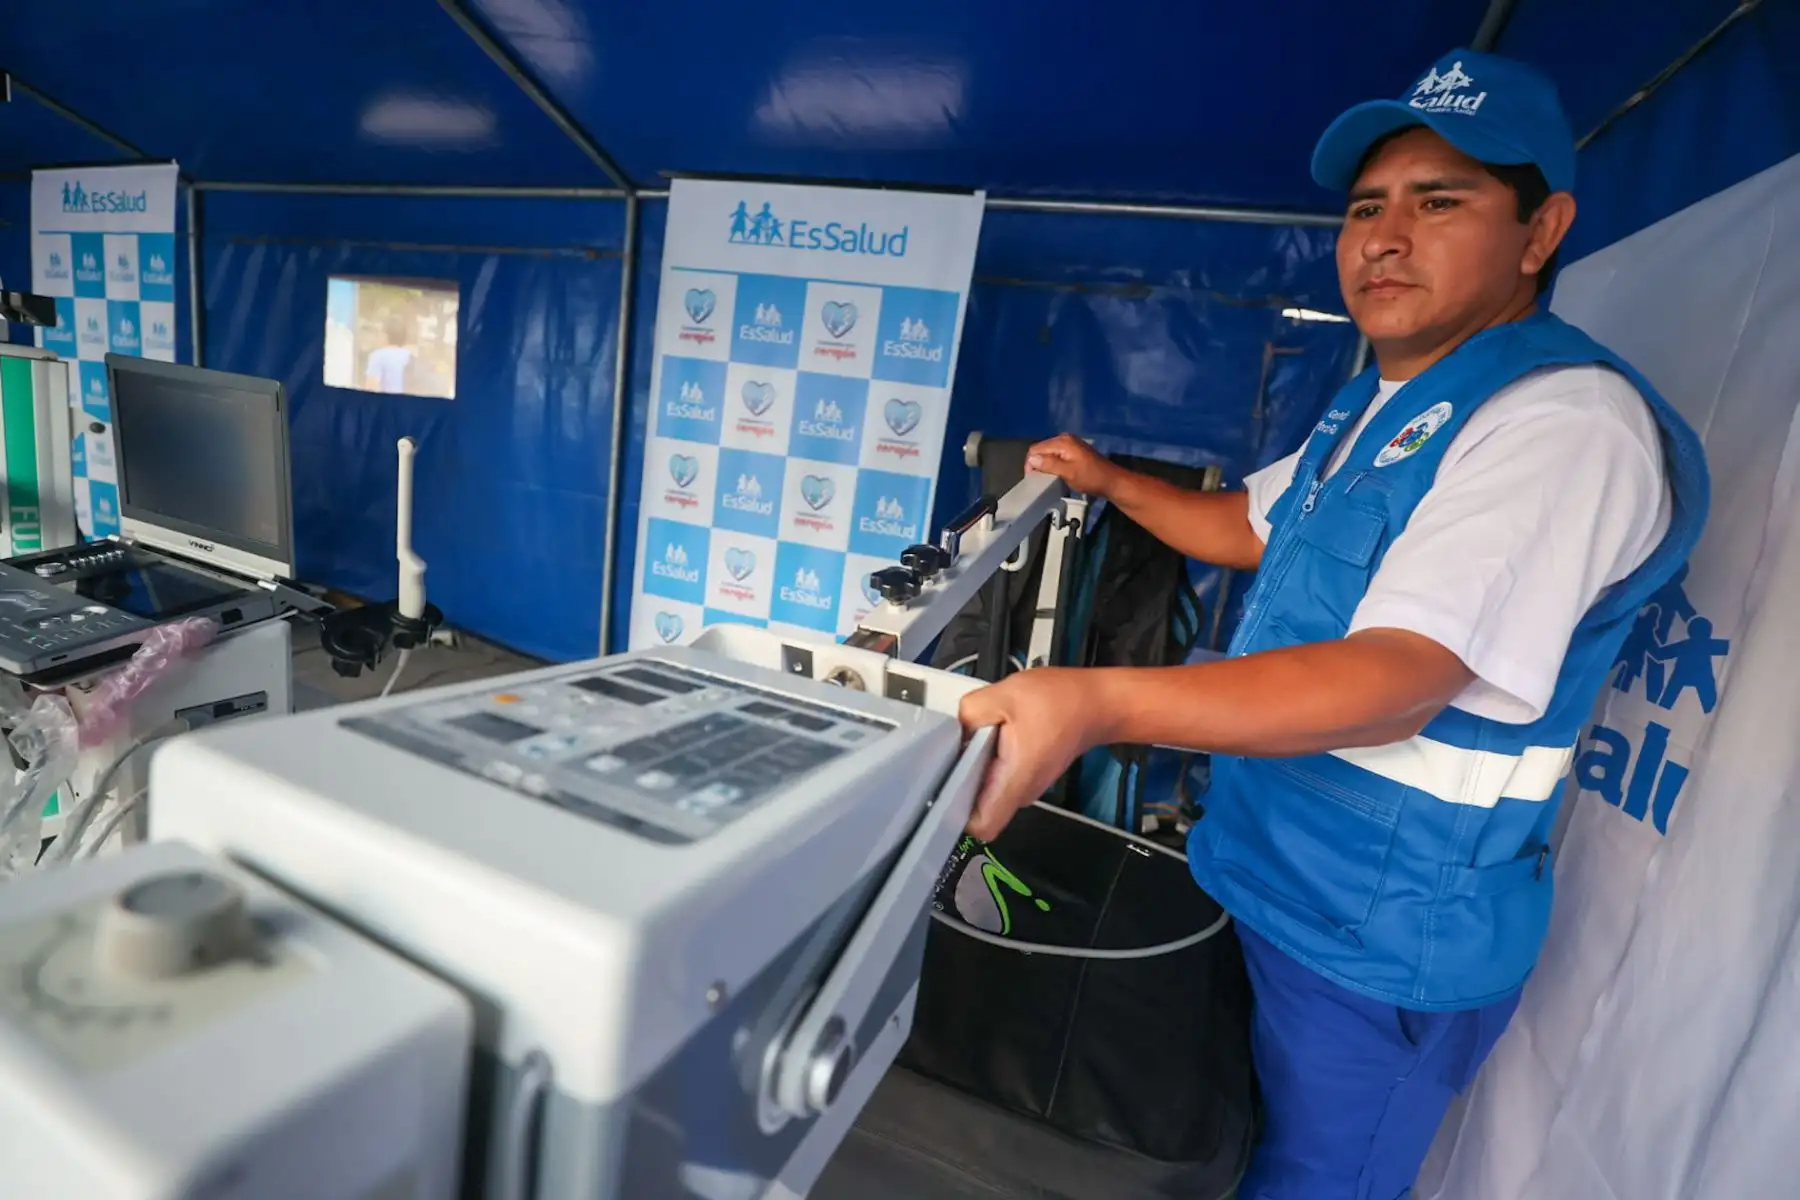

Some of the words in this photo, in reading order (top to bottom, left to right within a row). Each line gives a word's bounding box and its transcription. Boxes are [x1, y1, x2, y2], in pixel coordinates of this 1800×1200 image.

[91, 190, 146, 212] EsSalud
[789, 220, 908, 256] EsSalud
[739, 325, 793, 344] EsSalud
[883, 340, 943, 360] EsSalud
[667, 402, 715, 421] EsSalud
[799, 420, 853, 441] EsSalud
[722, 494, 773, 516] EsSalud
[860, 517, 916, 540] EsSalud
[652, 562, 699, 583] EsSalud
[780, 587, 832, 610] EsSalud
